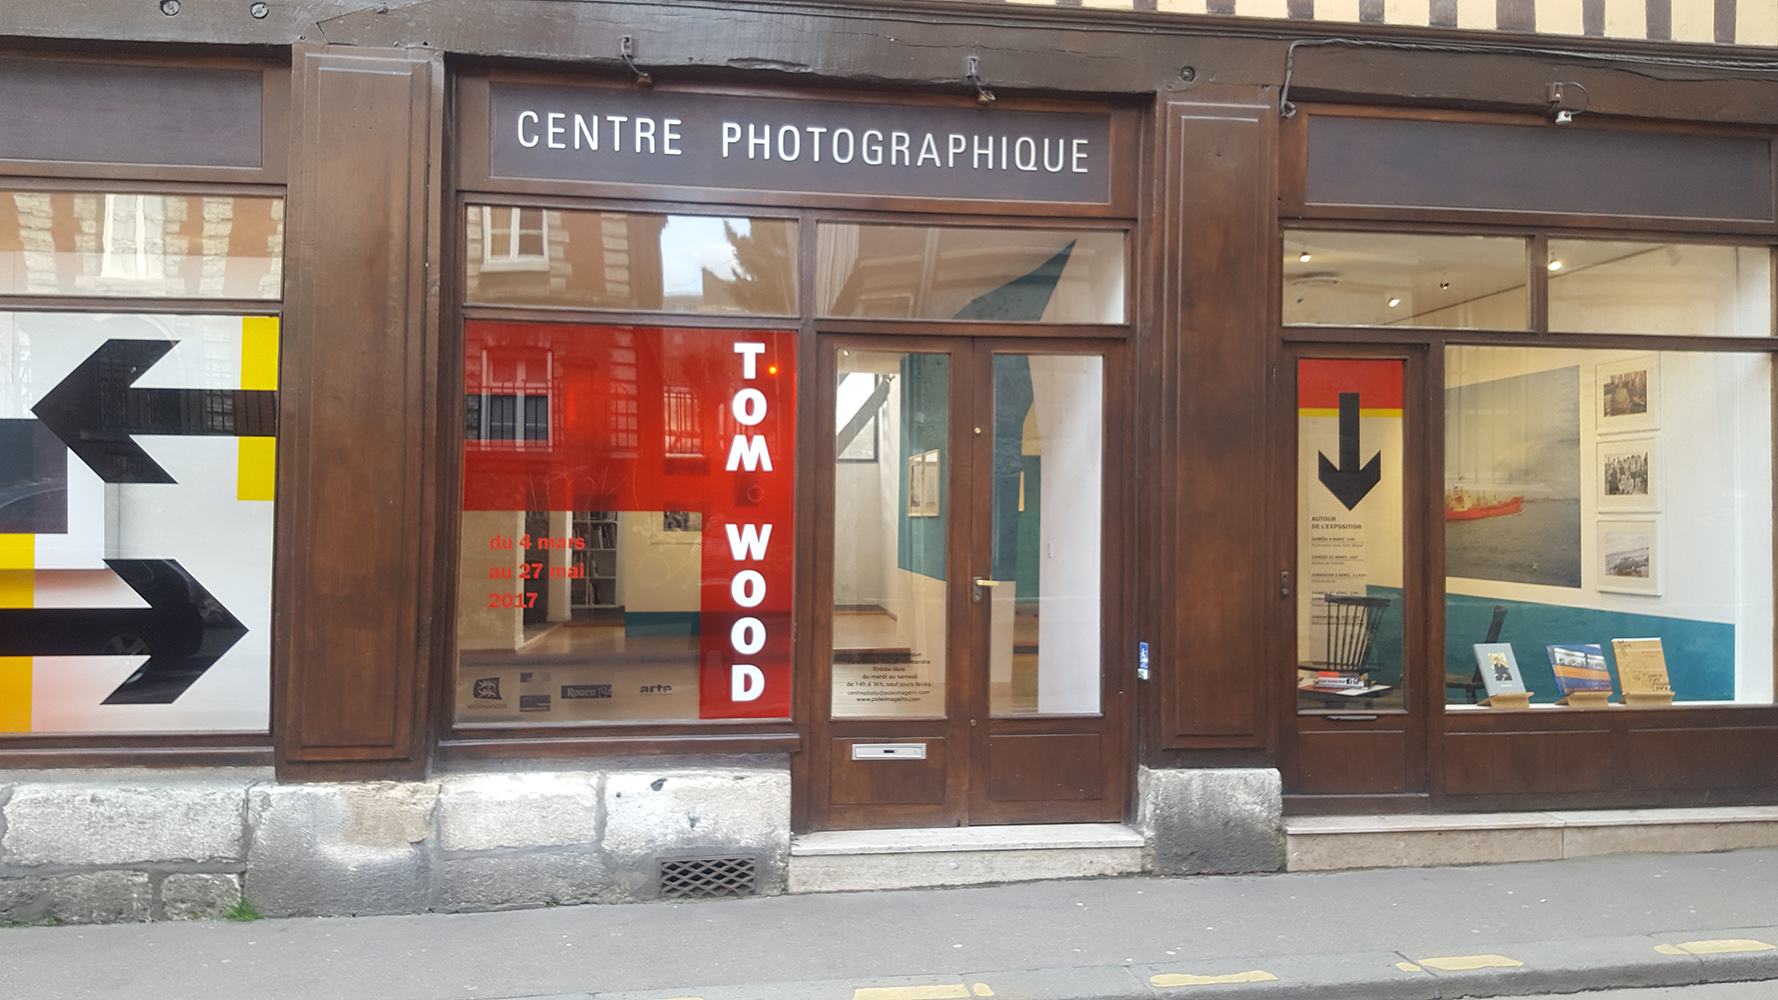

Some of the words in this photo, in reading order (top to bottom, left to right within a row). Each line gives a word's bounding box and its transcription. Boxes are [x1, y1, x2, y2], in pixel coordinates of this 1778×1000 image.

[517, 110, 682, 156] CENTRE
[721, 121, 1090, 175] PHOTOGRAPHIQUE
[725, 342, 774, 472] TOM
[489, 534, 513, 550] du
[519, 533, 532, 550] 4
[537, 537, 586, 550] mars
[488, 566, 512, 579] au
[518, 563, 544, 579] 27
[549, 562, 585, 579] mai
[487, 592, 538, 609] 2017
[725, 523, 773, 702] WOOD
[566, 687, 597, 698] Rouen
[639, 684, 672, 693] arte
